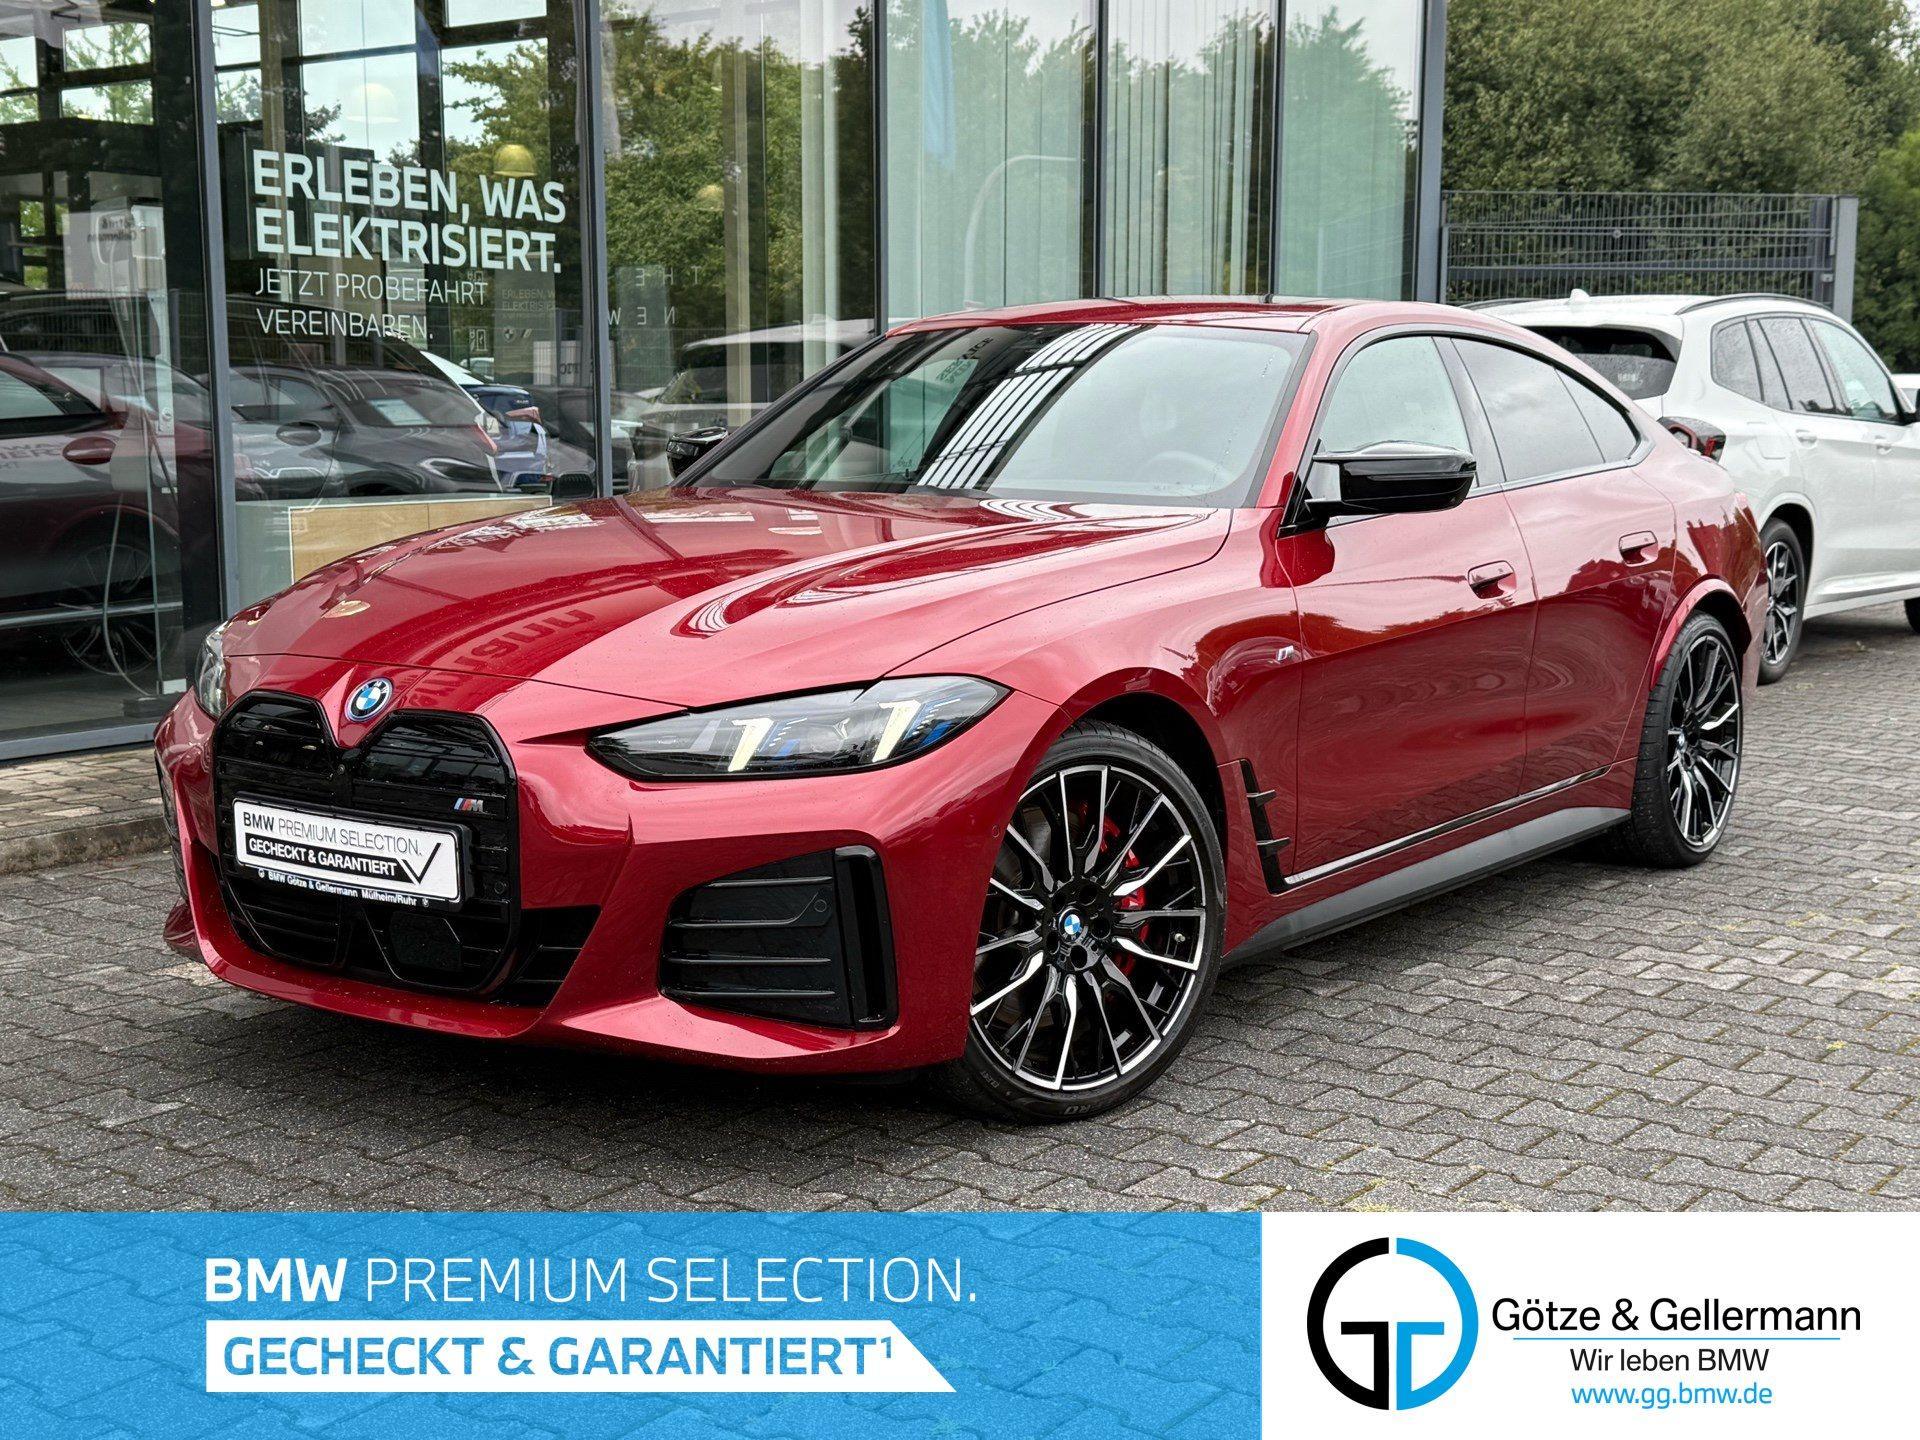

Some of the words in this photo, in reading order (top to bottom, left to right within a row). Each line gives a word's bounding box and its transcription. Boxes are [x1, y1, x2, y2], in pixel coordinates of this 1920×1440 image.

[253, 149, 470, 224] ERLEBEN,
[479, 174, 566, 224] WAS
[255, 207, 561, 273] ELEKTRISIERT.
[255, 268, 329, 296] JETZT
[336, 273, 488, 305] PROBEFAHRT
[256, 308, 434, 340] VEREINBAREN.
[243, 811, 275, 833] BMW
[278, 817, 337, 844] PREMIUM
[340, 828, 423, 857] SELECTION.
[249, 837, 307, 862] GECHECKT
[307, 849, 317, 864] &
[317, 851, 398, 877] GARANTIERT
[268, 870, 286, 884] BMW
[308, 880, 315, 890] &
[315, 881, 359, 898] Gellermann
